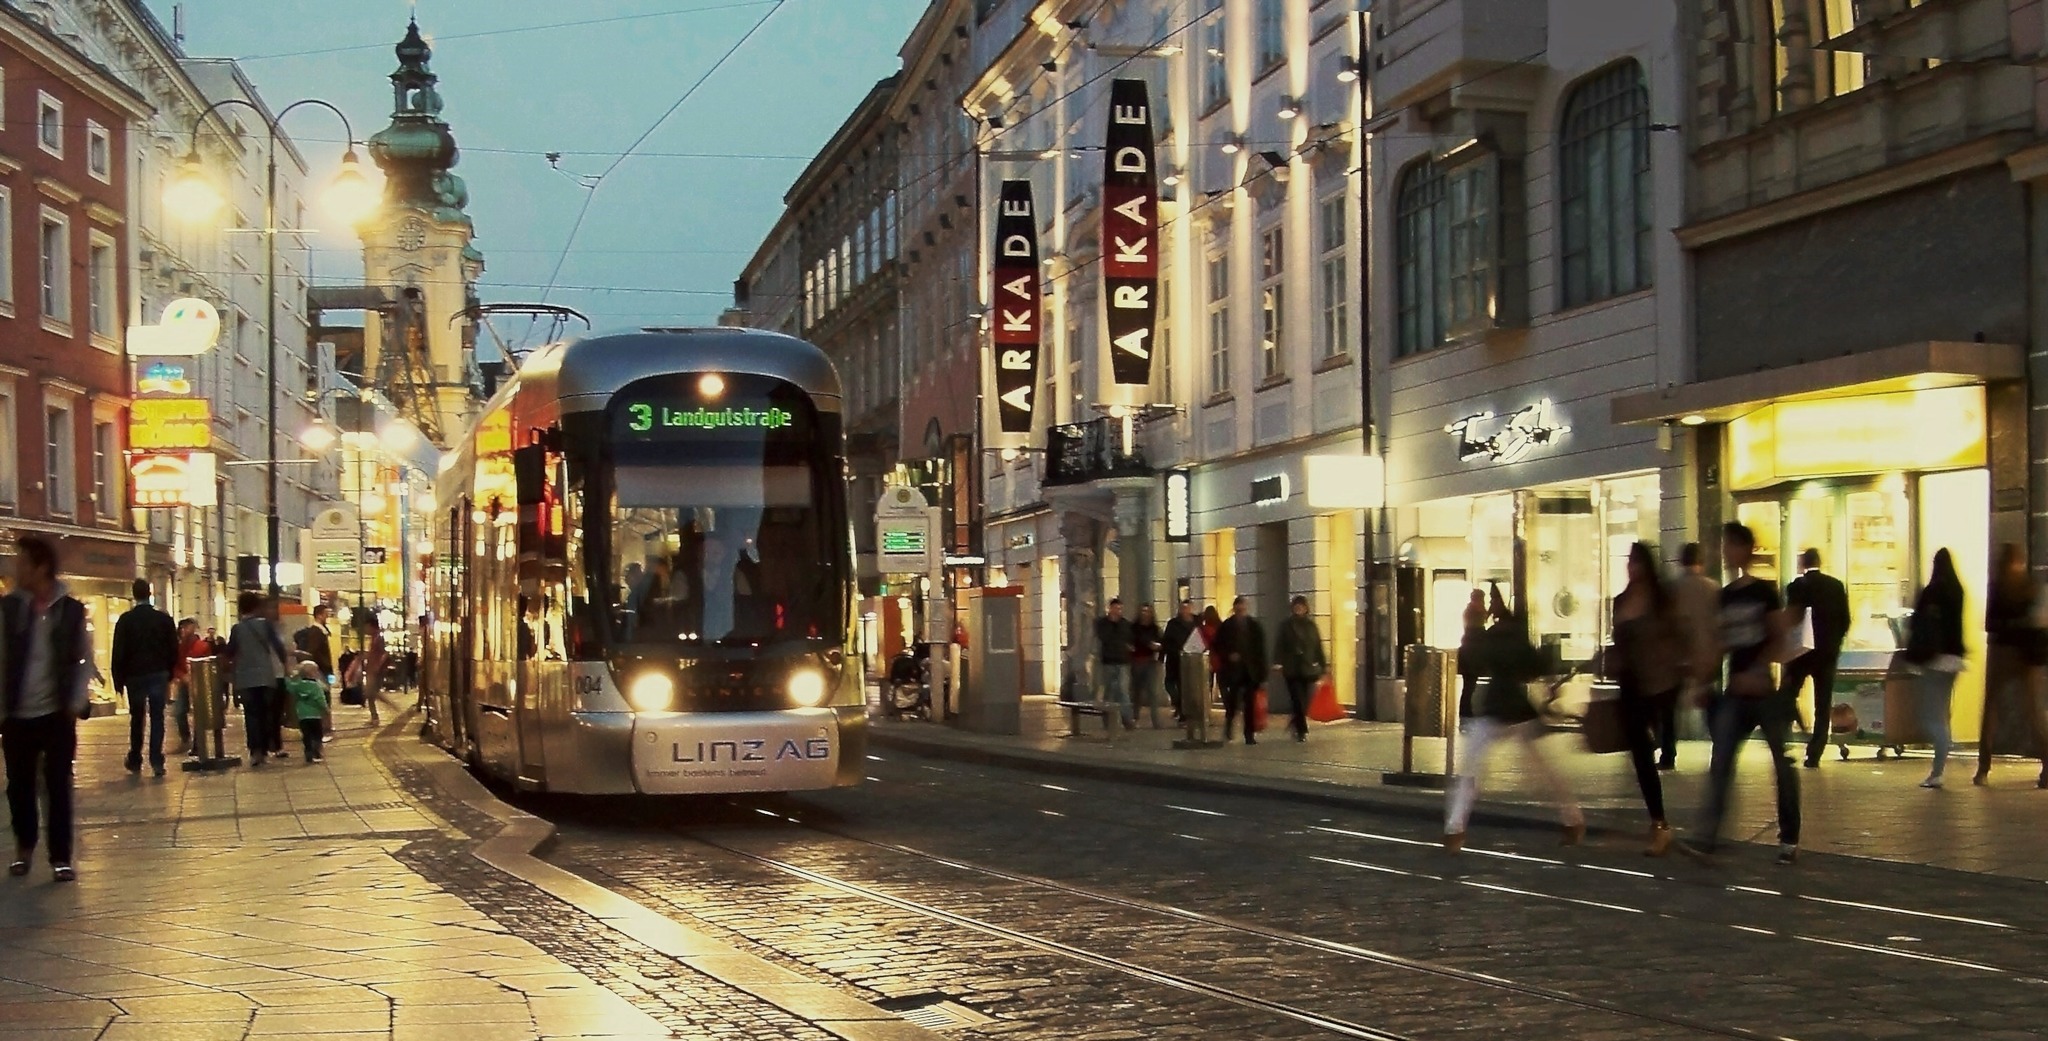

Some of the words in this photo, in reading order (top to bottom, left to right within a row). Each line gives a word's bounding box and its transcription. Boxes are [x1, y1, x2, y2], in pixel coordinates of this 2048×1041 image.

[1114, 105, 1148, 359] ARKADE
[1001, 200, 1031, 412] ARKADE
[629, 404, 652, 430] 3
[662, 407, 792, 429] Landgutstraße
[775, 739, 829, 760] AG
